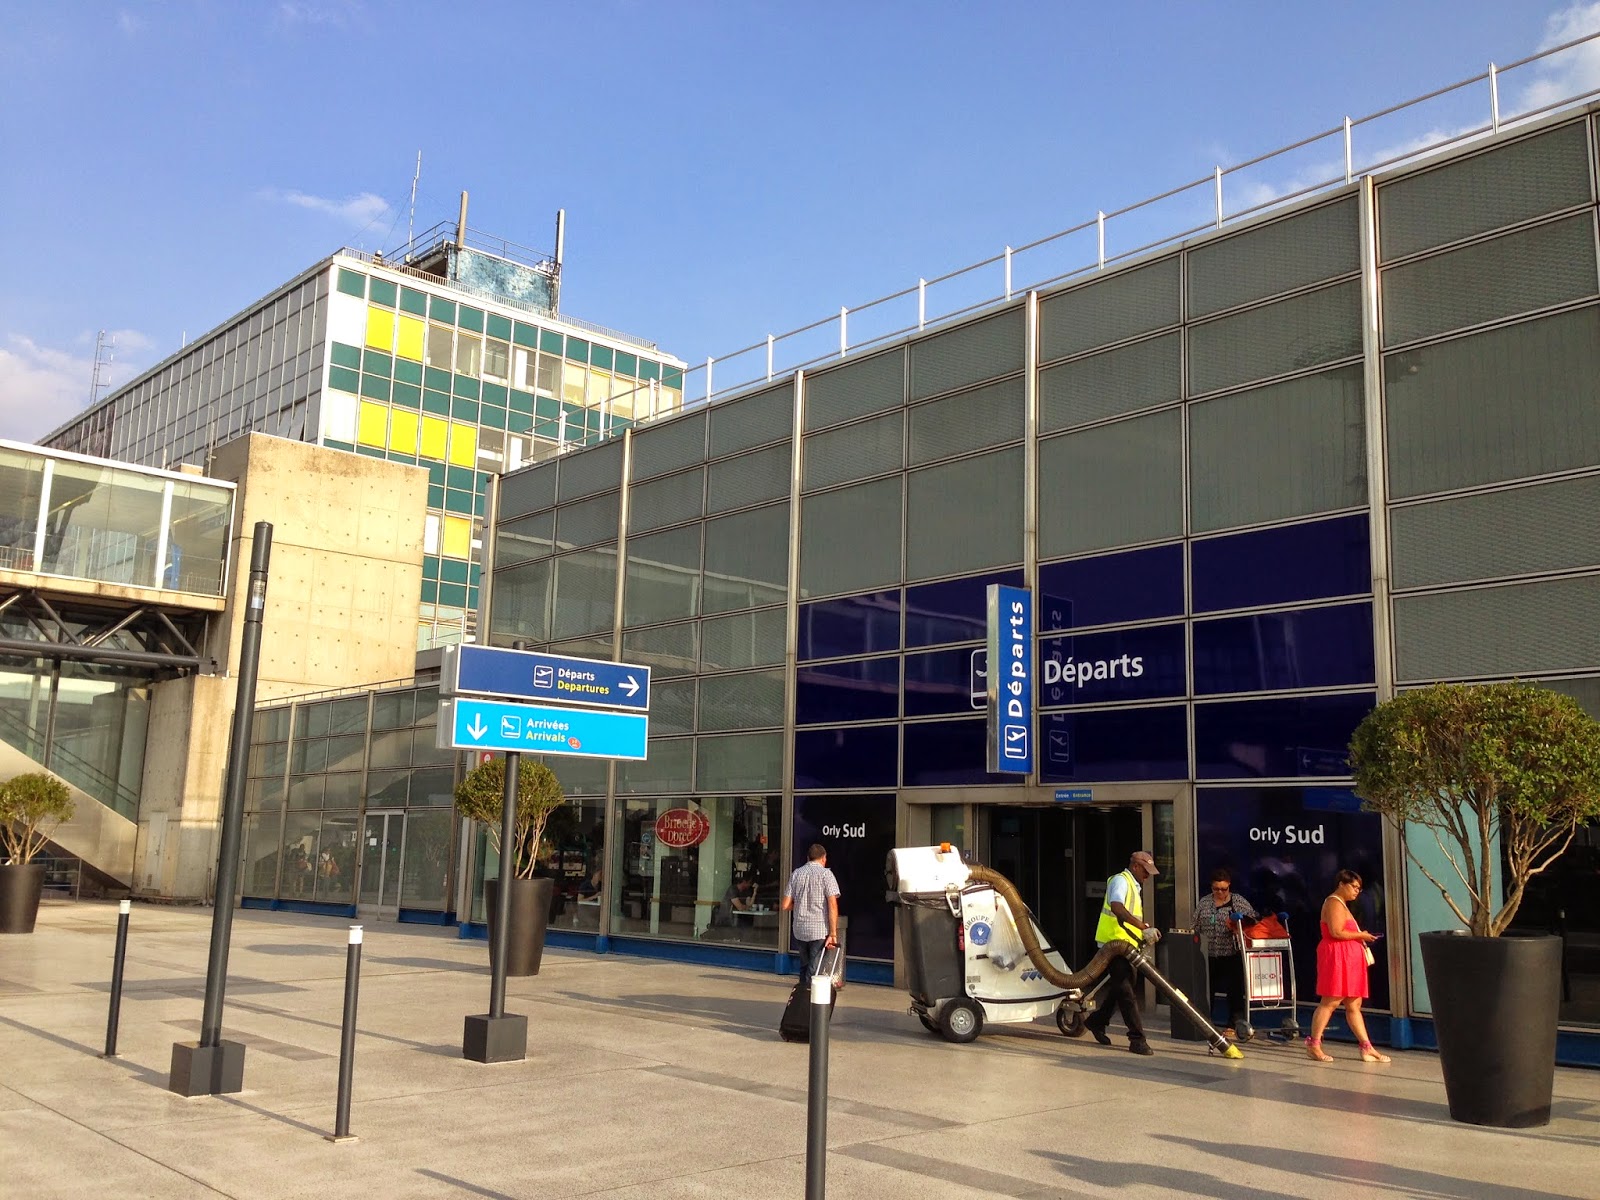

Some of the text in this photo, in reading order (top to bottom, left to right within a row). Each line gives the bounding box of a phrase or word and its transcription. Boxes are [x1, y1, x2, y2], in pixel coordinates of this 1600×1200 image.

[1007, 600, 1027, 718] Départs
[558, 668, 595, 681] Départs
[1044, 654, 1144, 688] Départs
[557, 680, 610, 695] Departures
[526, 718, 569, 731] Arrivées
[525, 730, 566, 743] Arrivals
[822, 822, 866, 839] Orly Sud
[1249, 825, 1325, 845] Orly Sud
[964, 914, 990, 931] GROUPE
